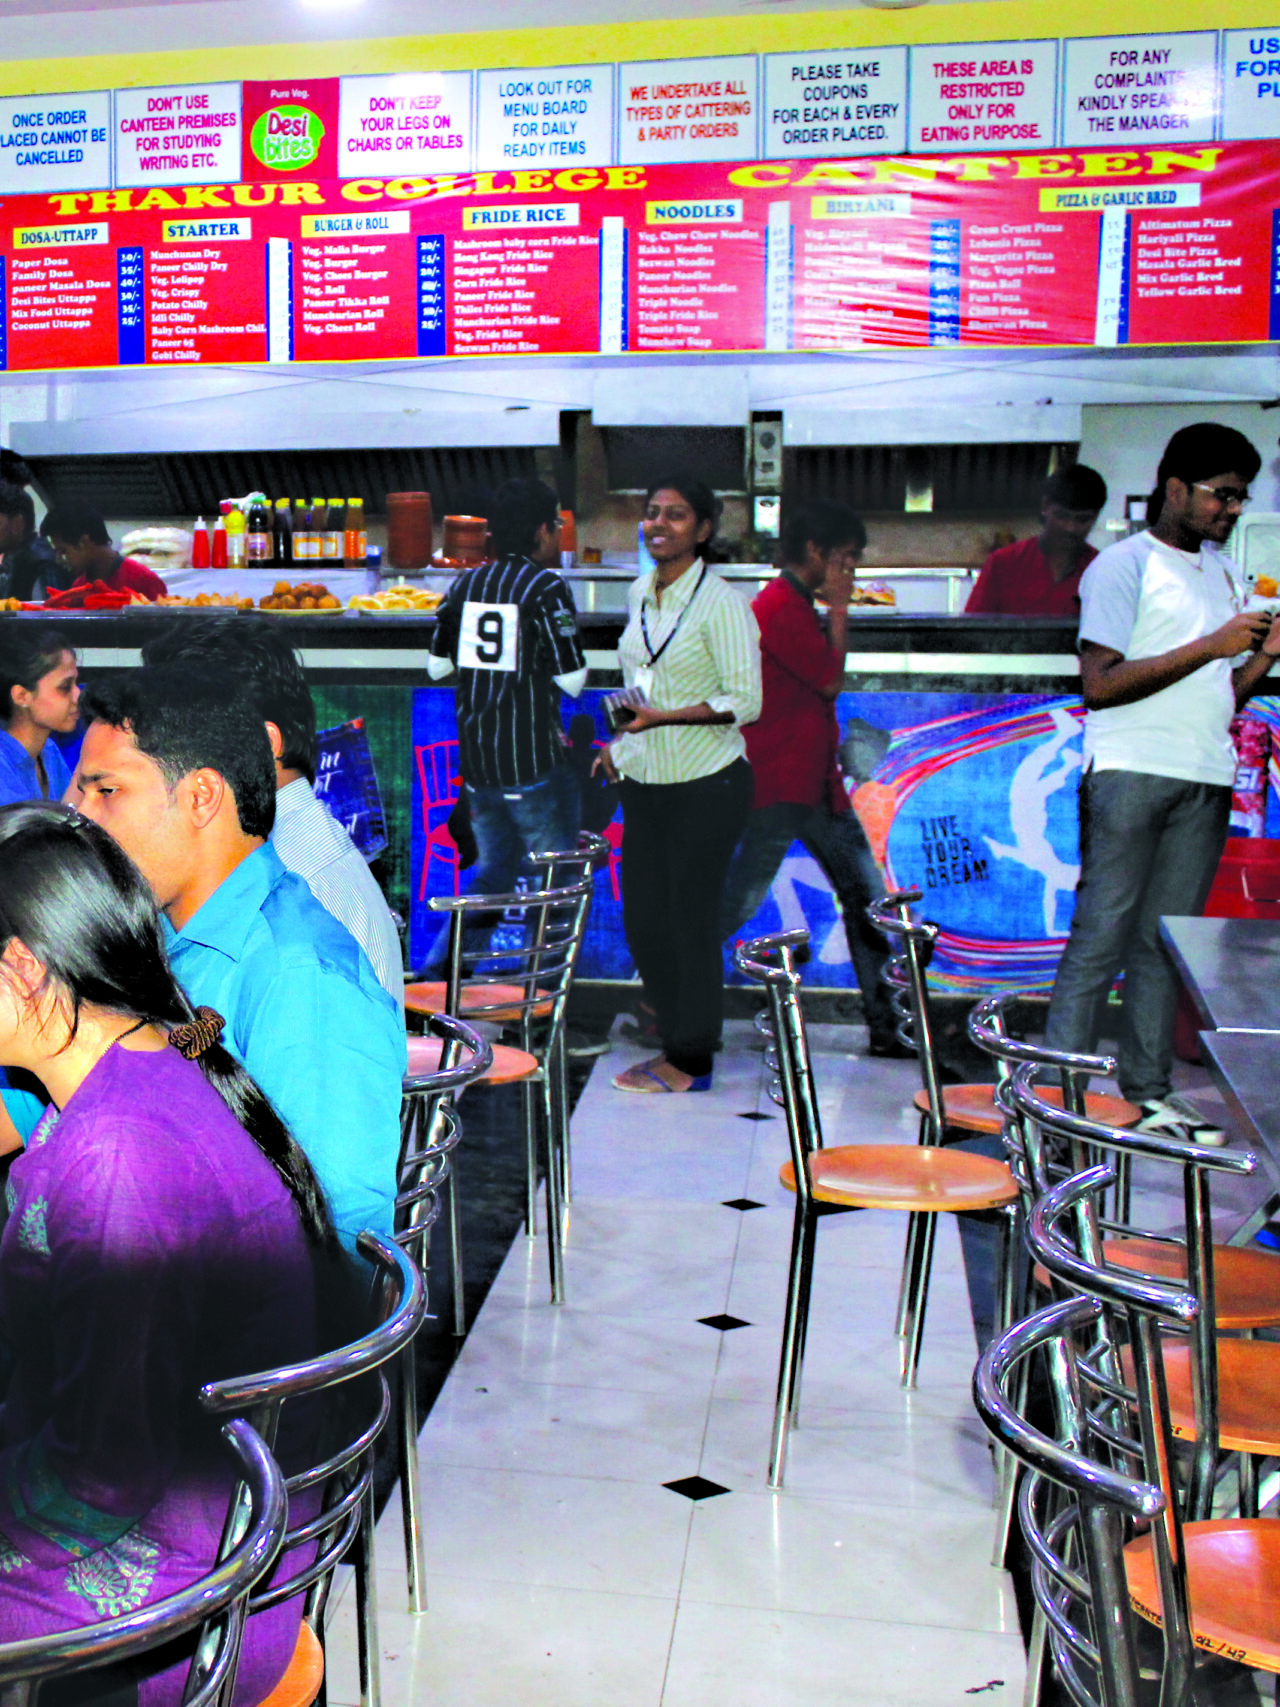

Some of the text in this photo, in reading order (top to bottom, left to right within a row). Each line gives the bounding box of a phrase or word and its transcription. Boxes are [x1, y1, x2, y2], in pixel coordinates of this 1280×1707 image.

[1110, 49, 1171, 66] FOR ANY
[792, 62, 880, 81] PLEASE TAKE
[933, 59, 1033, 78] THESE AREA IS
[499, 79, 592, 97] LOOK OUT FOR
[630, 80, 747, 101] WE UNDERTAKE ALL
[804, 84, 868, 101] COUPONS
[940, 82, 1024, 100] RESTRICTED
[148, 95, 209, 112] DON'T USE
[370, 95, 442, 112] DON'T KEEP
[504, 100, 587, 117] MENU BOARD
[627, 101, 751, 122] TYPES OF CATTERING
[1078, 95, 1127, 111] KINDLY
[13, 110, 86, 128] ONCE ORDER
[773, 104, 898, 124] FOR EACH & EVERY
[948, 104, 1015, 121] ONLY FOR
[121, 113, 236, 133] CANTEEN PREMISES
[268, 113, 308, 138] Desi
[360, 114, 451, 132] YOUR LEGS ON
[513, 120, 576, 137] FOR DAILY
[638, 123, 738, 141] & PARTY ORDERS
[1088, 114, 1189, 132] THE MANAGER
[41, 130, 89, 146] CANNOT
[92, 128, 106, 142] BE
[783, 125, 888, 145] ORDER PLACED.
[922, 124, 1042, 142] EATING PURPOSE.
[136, 133, 221, 152] FOR STUDYING
[266, 138, 312, 162] bites
[348, 134, 462, 152] CHAIRS OR TABLES
[504, 140, 586, 158] READY ITEMS
[16, 149, 83, 166] CANCELLED
[140, 153, 217, 171] WRITING ETC.
[47, 148, 1224, 216] THAKUR COLLEGE CANTEEN
[472, 209, 566, 224] FRIDE RICE
[655, 204, 735, 219] NOODLES
[168, 223, 240, 237] STARTER
[366, 217, 389, 229] ROLL
[21, 228, 98, 244] DOSA-UTTAPP
[476, 611, 504, 664] 9
[921, 815, 960, 841] LIVE
[923, 838, 973, 864] YOUR
[927, 859, 989, 888] DREAM
